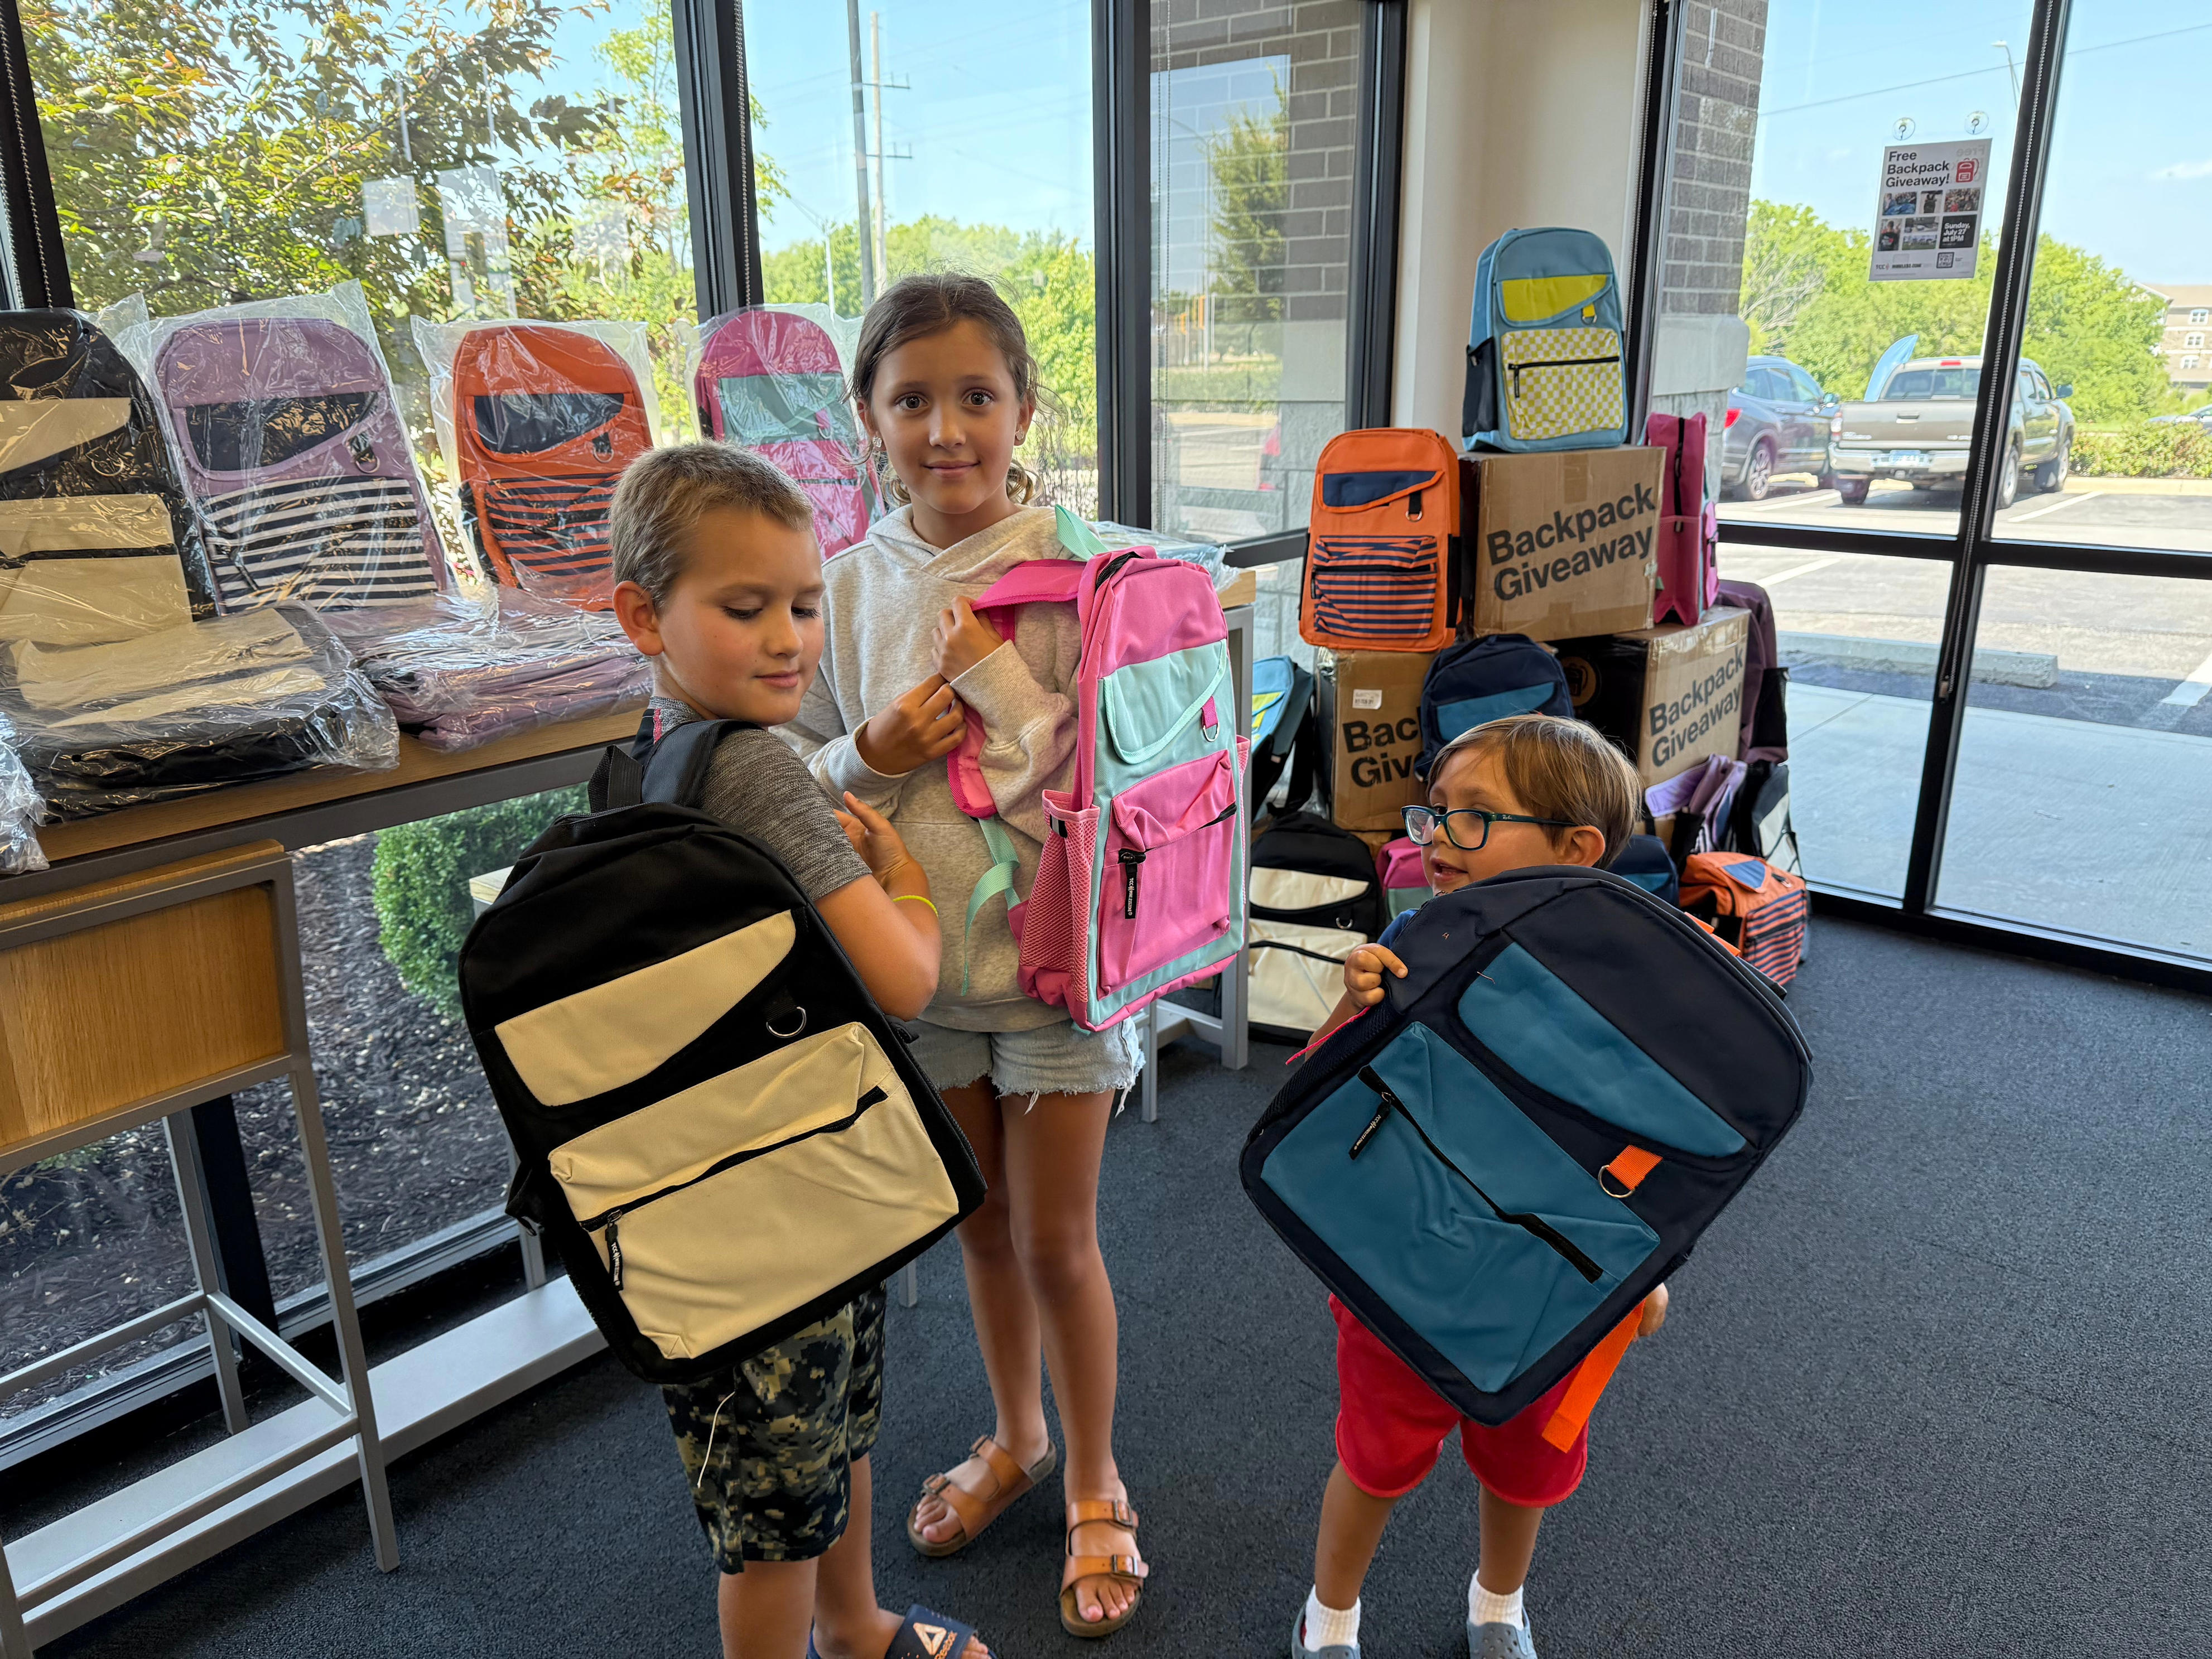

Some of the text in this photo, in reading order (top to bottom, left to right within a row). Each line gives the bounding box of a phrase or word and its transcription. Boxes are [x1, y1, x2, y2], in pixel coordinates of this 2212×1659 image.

[1886, 173, 1950, 187] Giveaway!
[1887, 161, 1950, 175] Backpack
[1889, 151, 1917, 162] Free
[1487, 483, 1655, 566] Backpack
[1494, 527, 1653, 601] Giveaway
[1649, 645, 1743, 736] Backpack
[1652, 682, 1742, 767] Giveaway
